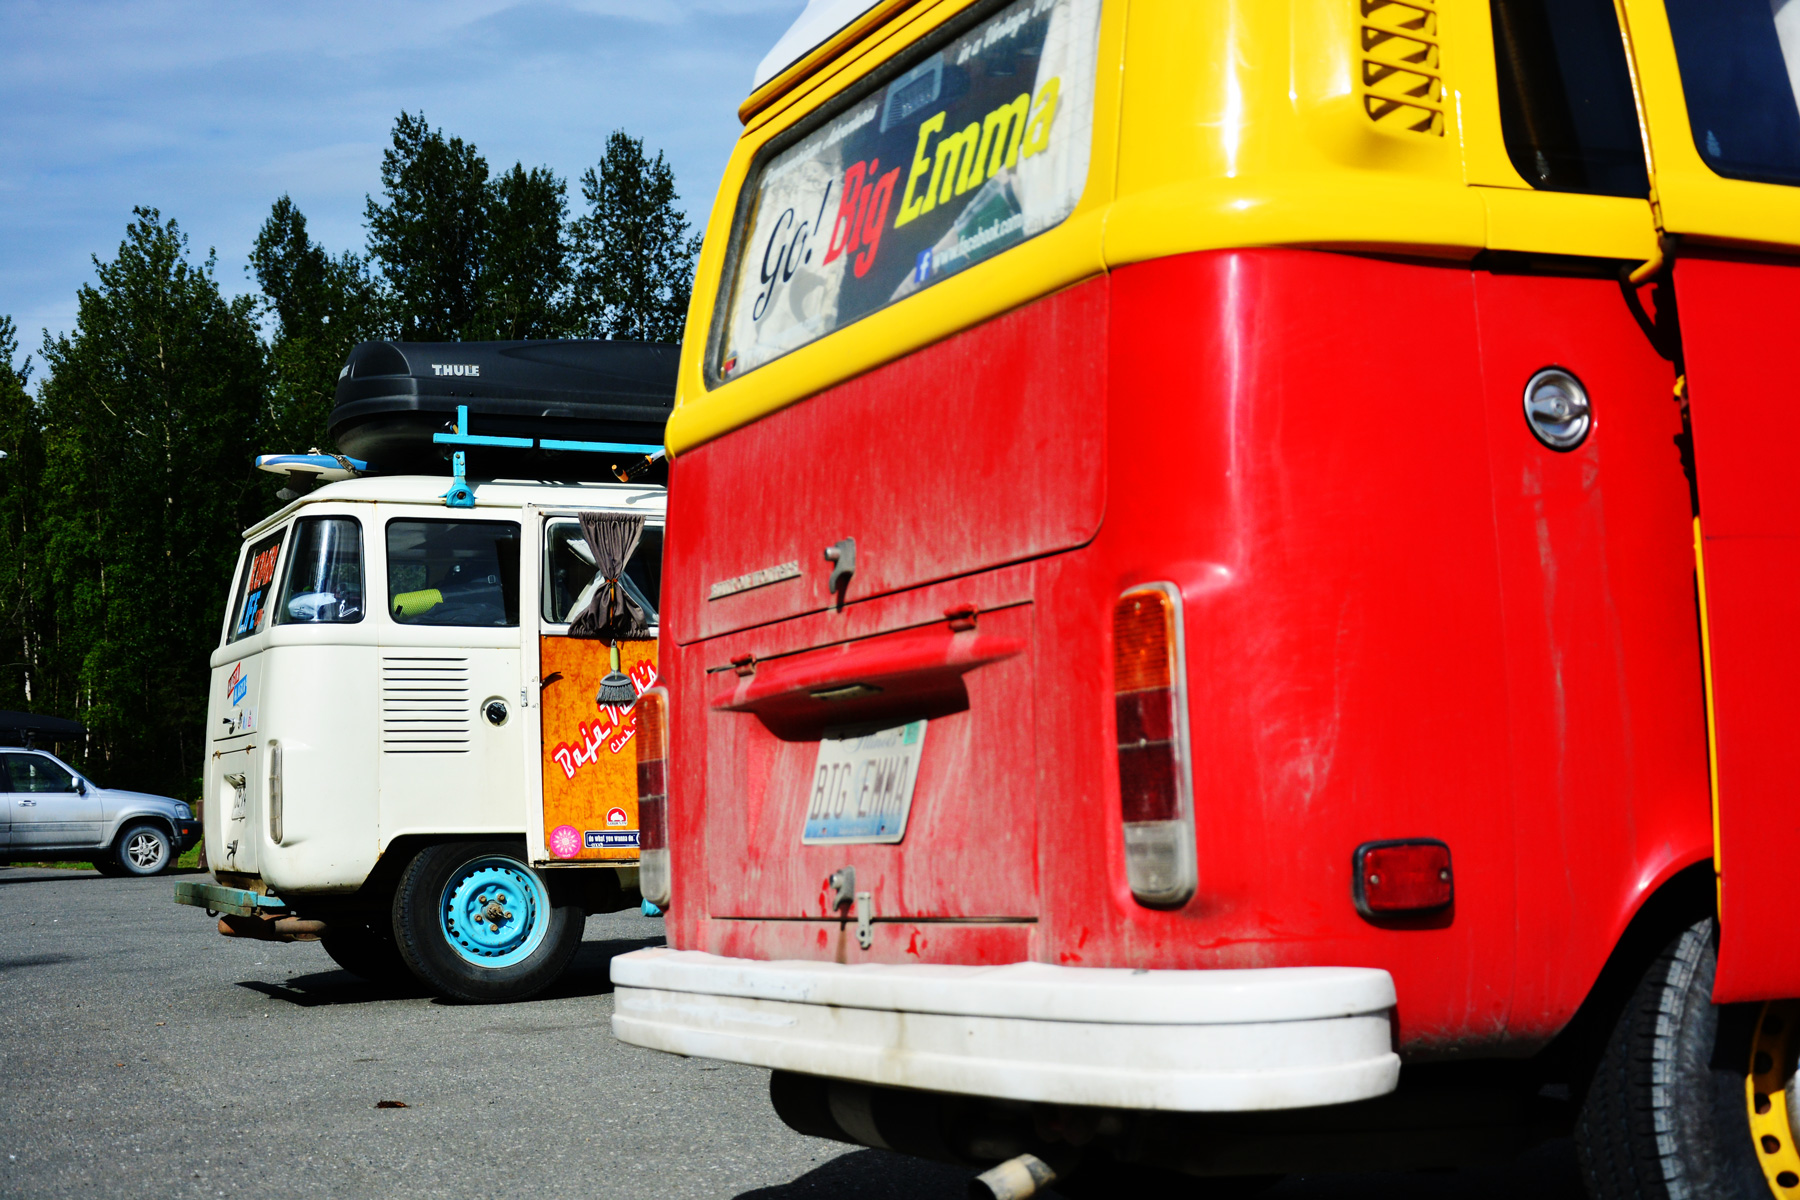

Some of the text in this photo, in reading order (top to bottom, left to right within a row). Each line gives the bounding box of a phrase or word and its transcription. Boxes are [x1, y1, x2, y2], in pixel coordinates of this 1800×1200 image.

[754, 76, 1060, 320] Go! Big Emma
[432, 364, 479, 376] THULE
[237, 590, 262, 635] LIFE
[554, 665, 658, 779] Baja Vk's
[810, 756, 909, 820] BIG EMMA
